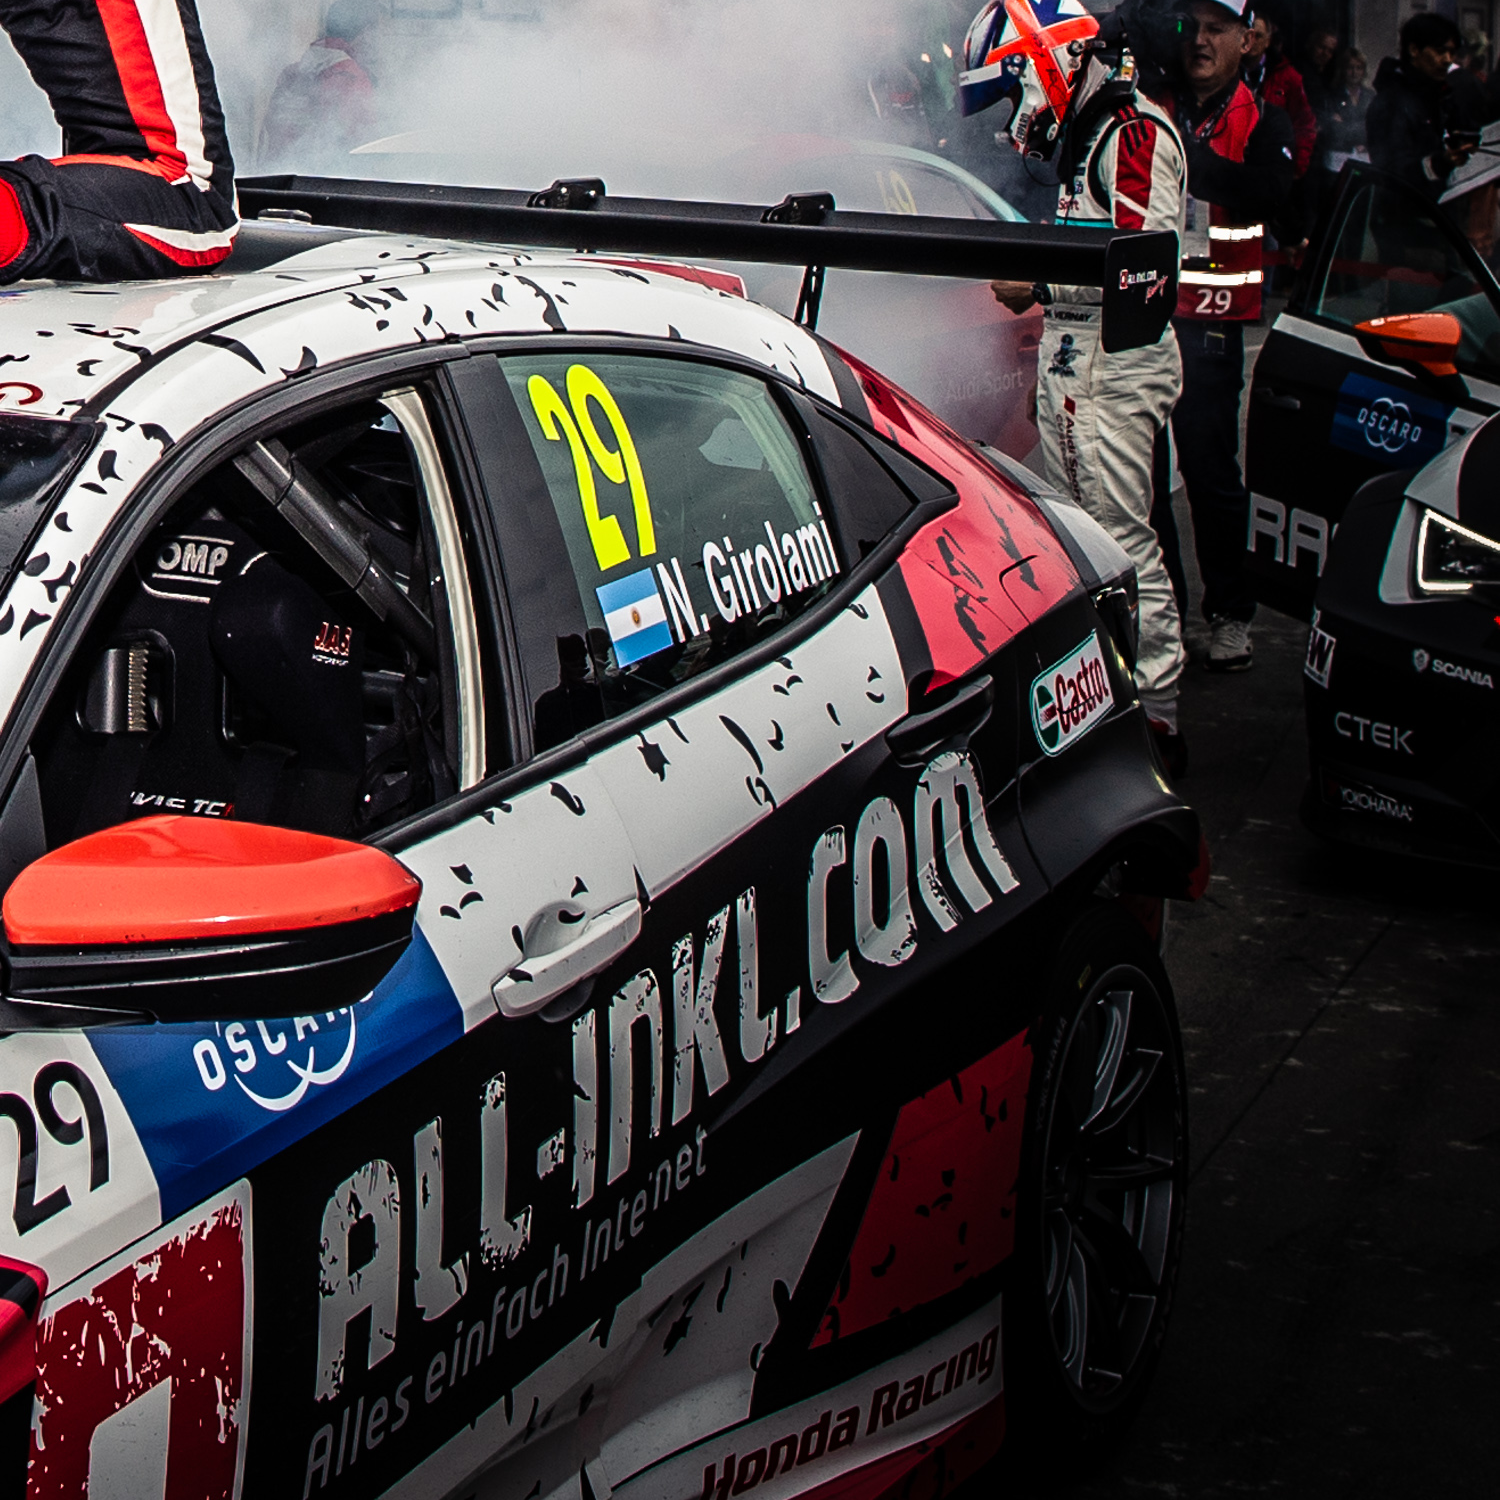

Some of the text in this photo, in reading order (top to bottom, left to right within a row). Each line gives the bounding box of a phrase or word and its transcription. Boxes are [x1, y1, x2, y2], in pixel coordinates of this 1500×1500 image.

[1195, 288, 1232, 315] 29
[1065, 416, 1077, 454] Audi
[1357, 407, 1422, 445] OSCARO
[527, 363, 657, 571] 29
[156, 541, 229, 576] OMP
[656, 501, 841, 644] N. Girolami
[1054, 653, 1110, 735] Castrol
[1433, 658, 1494, 690] SCANIA
[1335, 711, 1414, 755] CTEK
[302, 1376, 411, 1500] Alles
[423, 1249, 568, 1406] einfach
[700, 1329, 1000, 1500] Honda Racing
